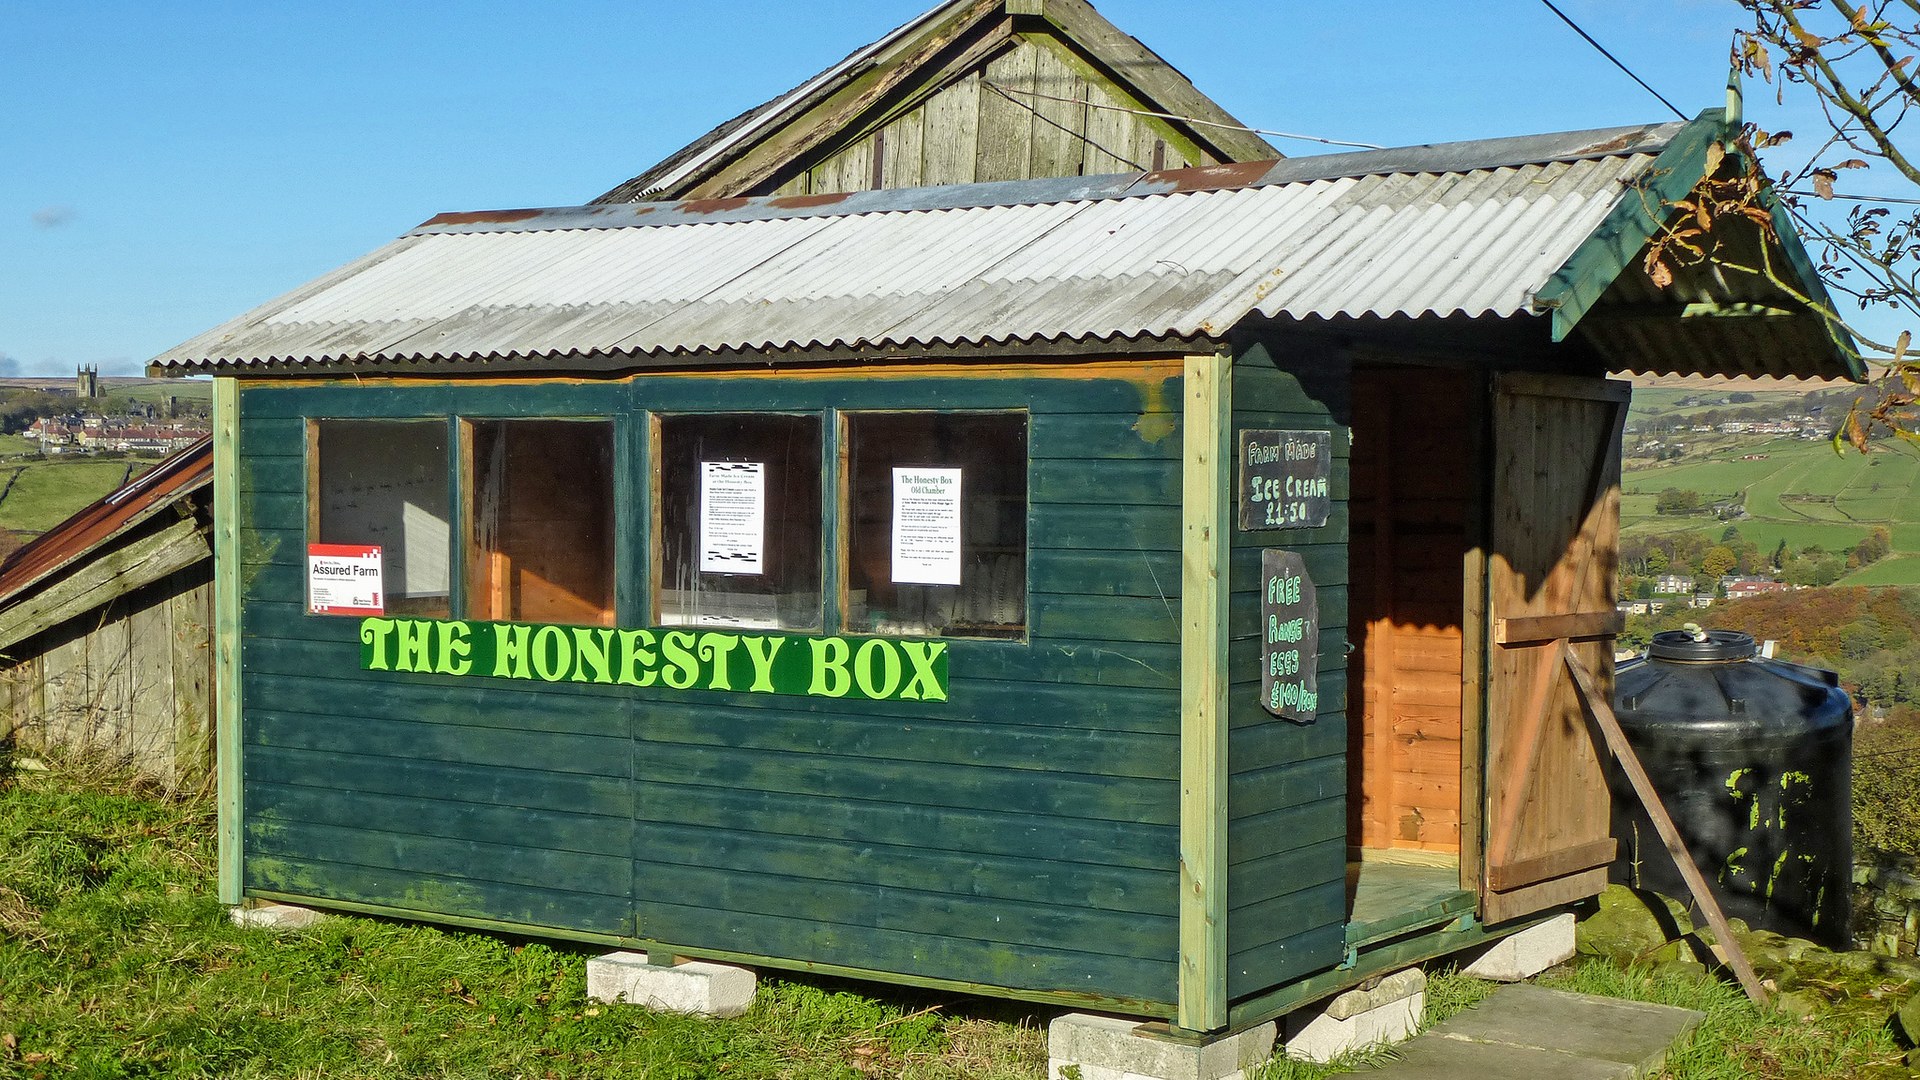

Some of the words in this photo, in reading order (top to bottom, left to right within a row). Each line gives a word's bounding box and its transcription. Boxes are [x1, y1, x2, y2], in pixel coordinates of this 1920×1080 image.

[1248, 441, 1280, 467] FARM
[1284, 441, 1317, 461] MADE
[901, 474, 913, 484] The
[914, 475, 939, 485] Honesty
[940, 475, 953, 485] Box
[911, 486, 921, 494] Old
[922, 486, 946, 495] Chamber
[1251, 476, 1281, 502] ICE
[1286, 475, 1327, 498] CREAM
[313, 563, 351, 576] Assured
[353, 565, 379, 577] Farm
[1268, 575, 1301, 606] FREE
[360, 617, 473, 676] THE
[492, 623, 786, 693] HONESTY
[807, 636, 947, 701] BOX
[1270, 649, 1299, 677] EGGS
